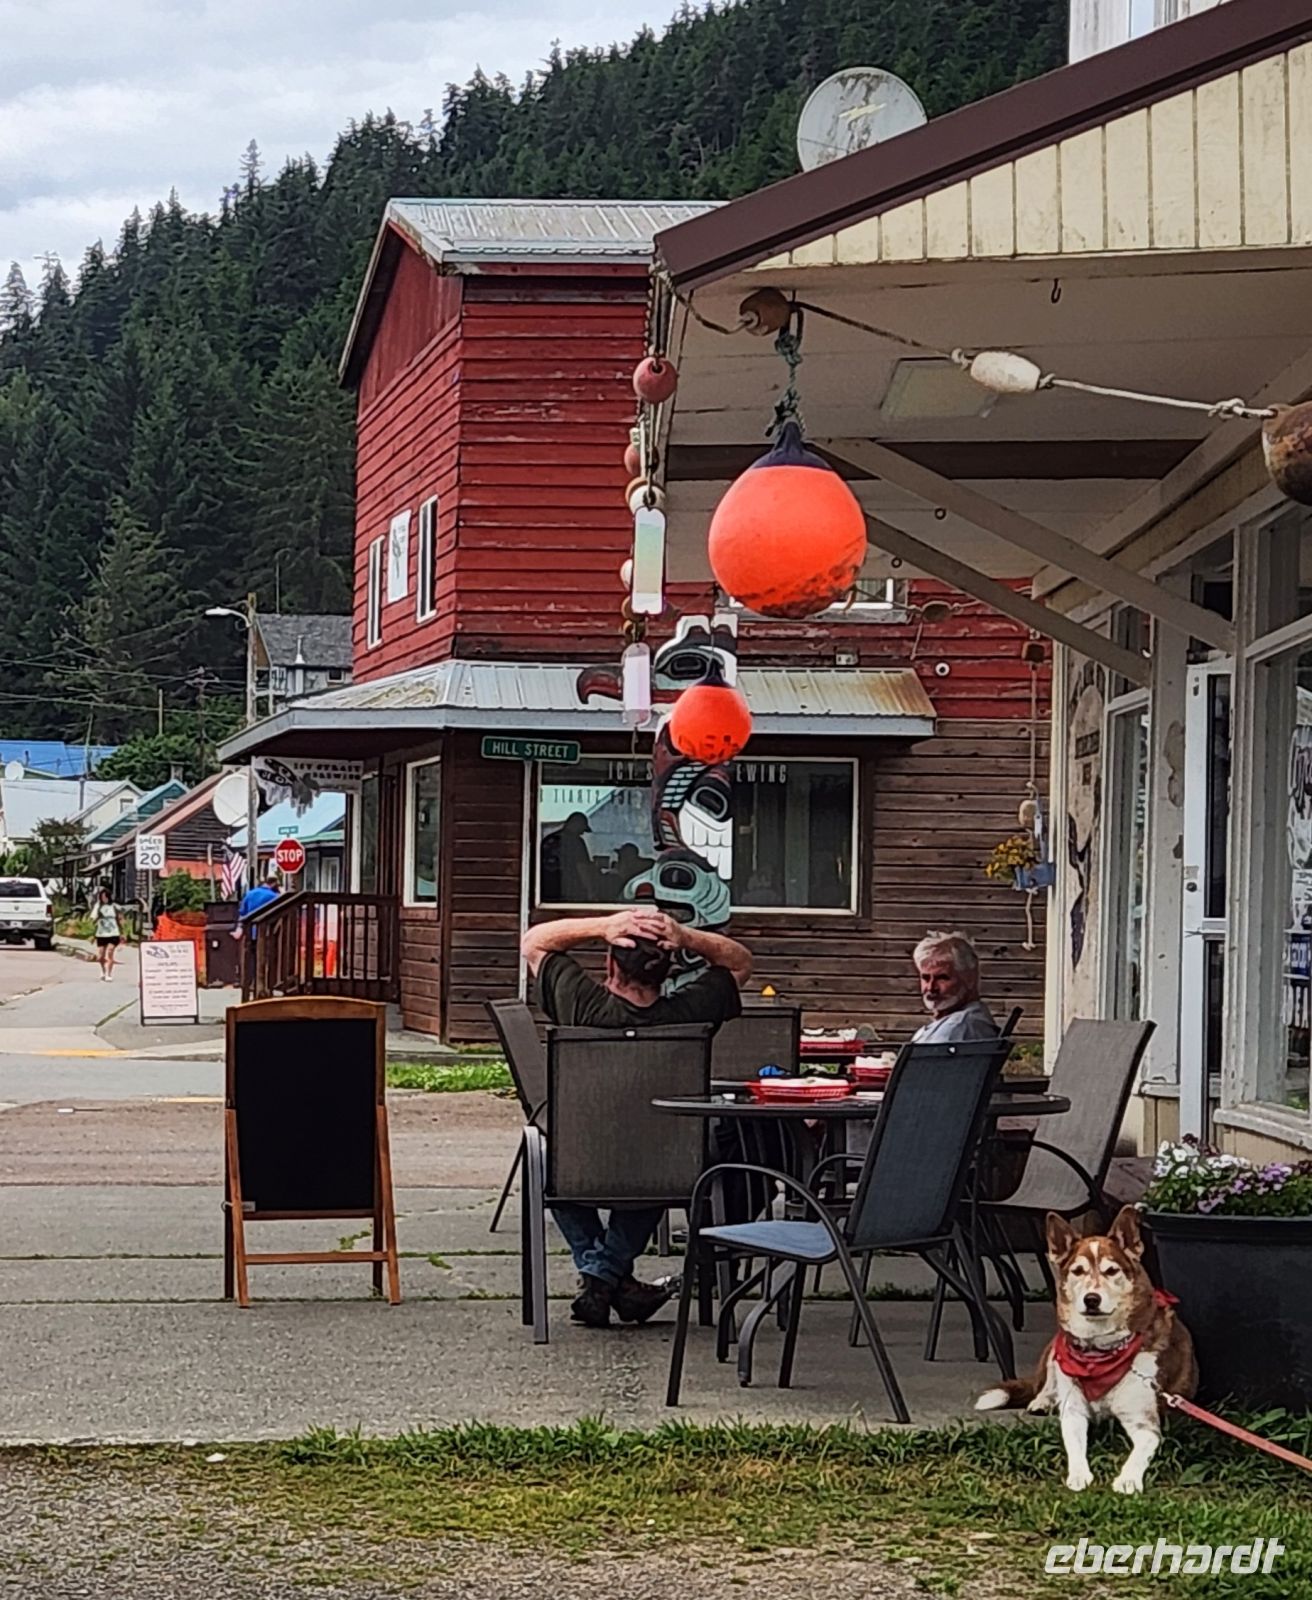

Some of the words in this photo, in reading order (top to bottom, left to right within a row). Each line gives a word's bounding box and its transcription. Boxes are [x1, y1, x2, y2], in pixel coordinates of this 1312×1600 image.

[492, 741, 519, 756] HILL
[524, 743, 569, 759] STREET
[608, 760, 634, 780] ICY
[736, 763, 787, 783] EWING
[140, 852, 162, 866] 20
[277, 849, 303, 862] STOP
